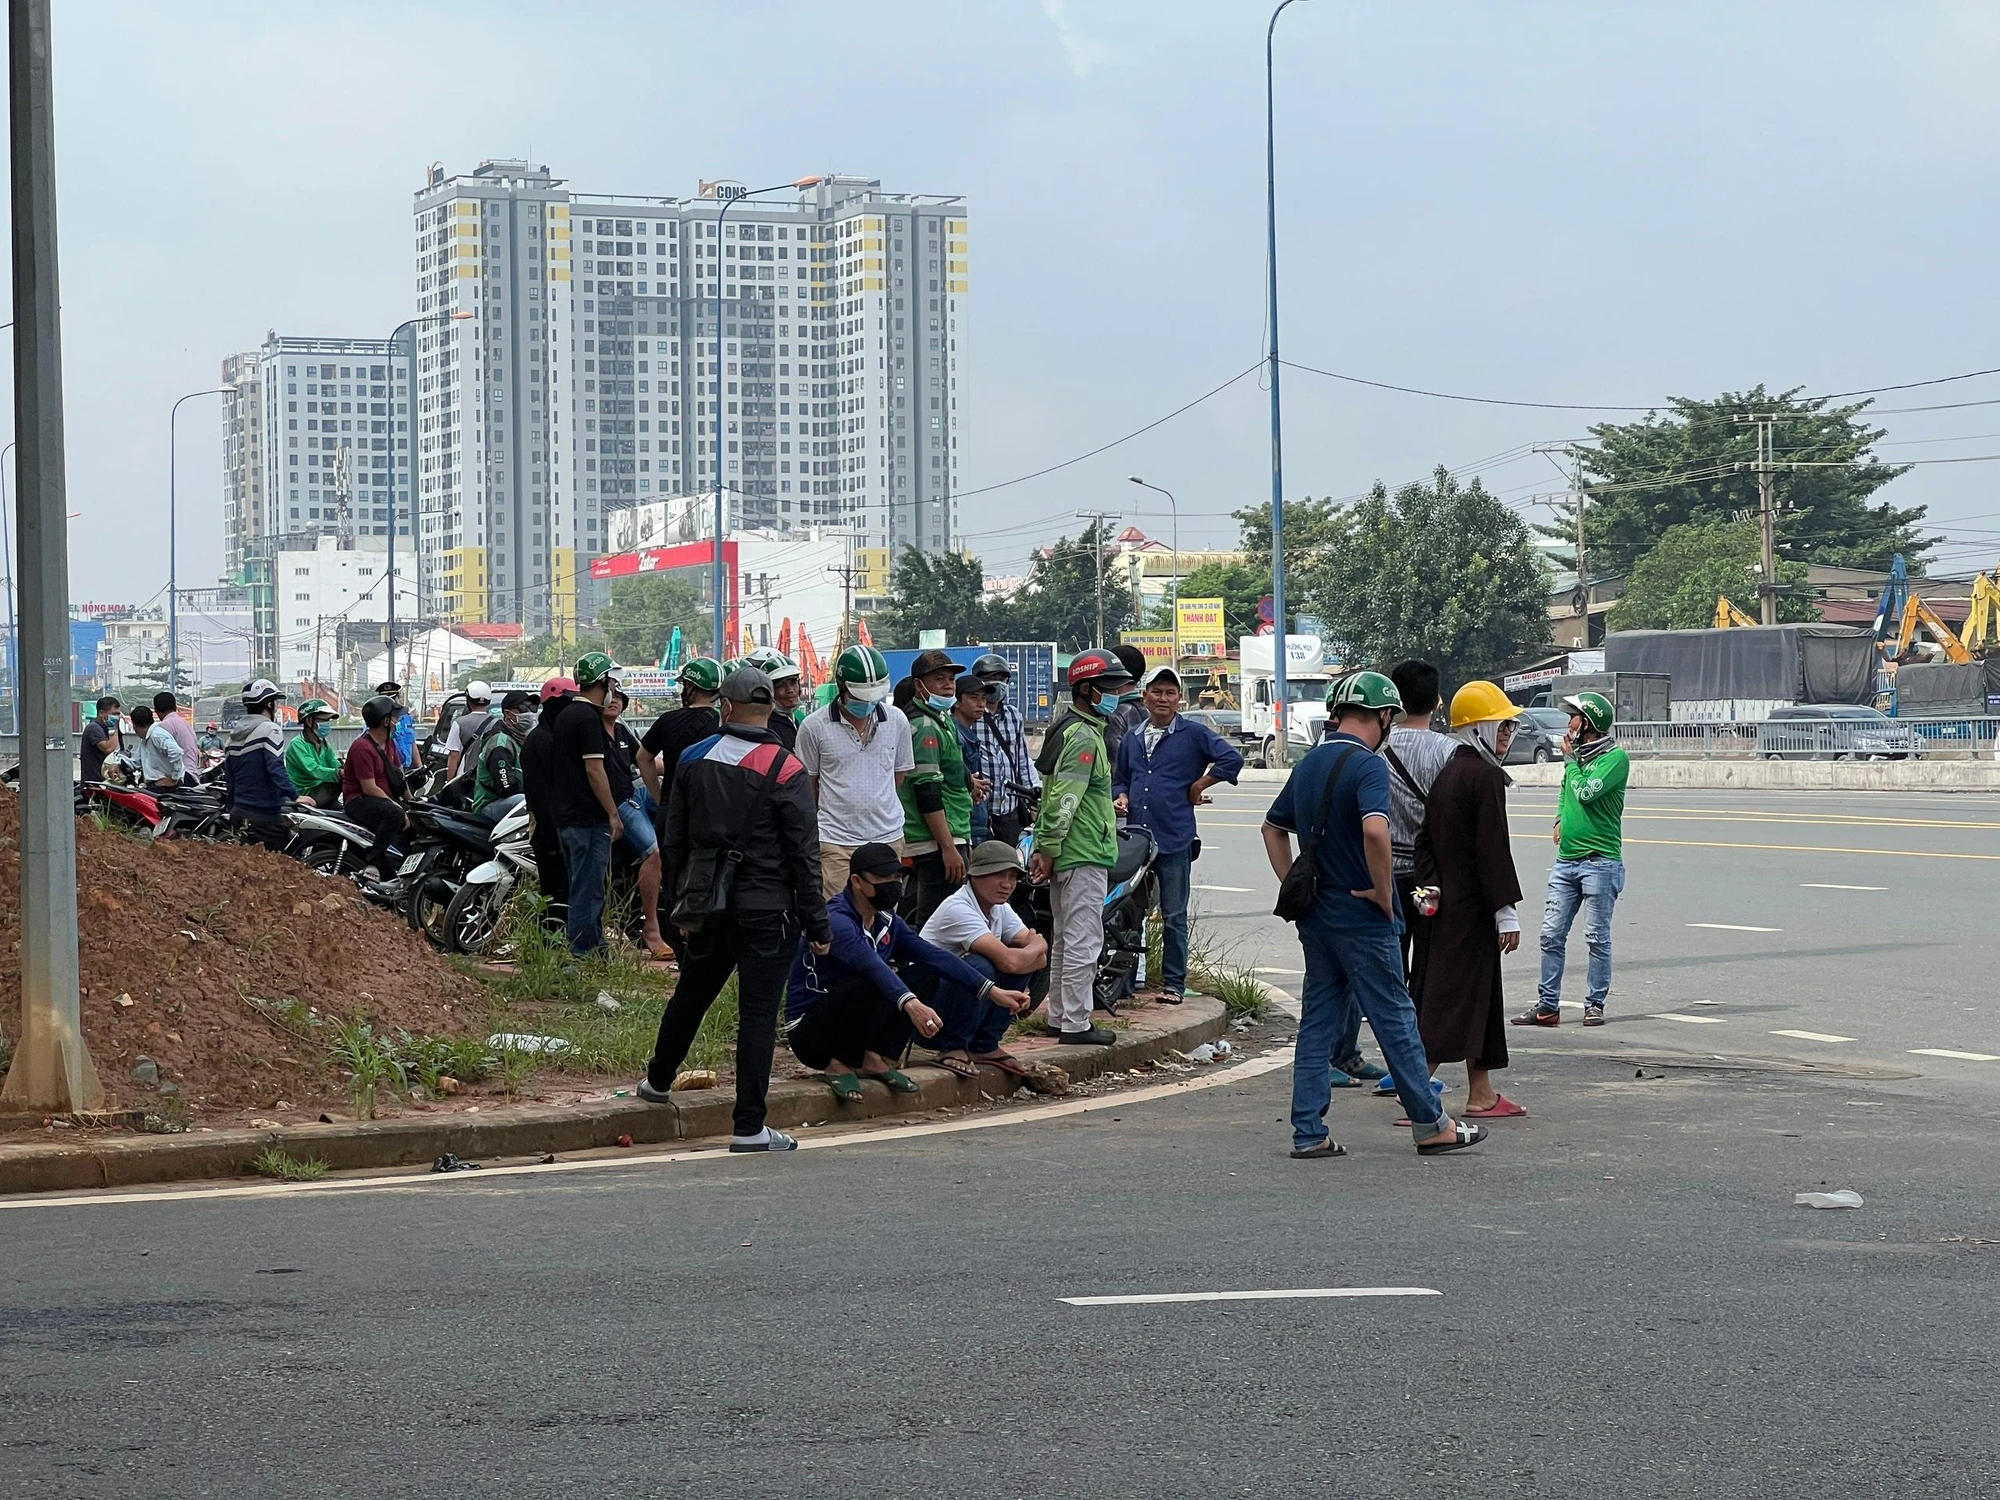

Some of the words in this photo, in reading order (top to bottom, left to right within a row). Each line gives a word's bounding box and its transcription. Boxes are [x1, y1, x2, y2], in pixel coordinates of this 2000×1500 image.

[716, 186, 747, 199] CONS
[588, 656, 605, 670] Grab
[685, 667, 702, 680] Grab
[1382, 686, 1399, 698] Gra
[1587, 700, 1604, 718] Grab
